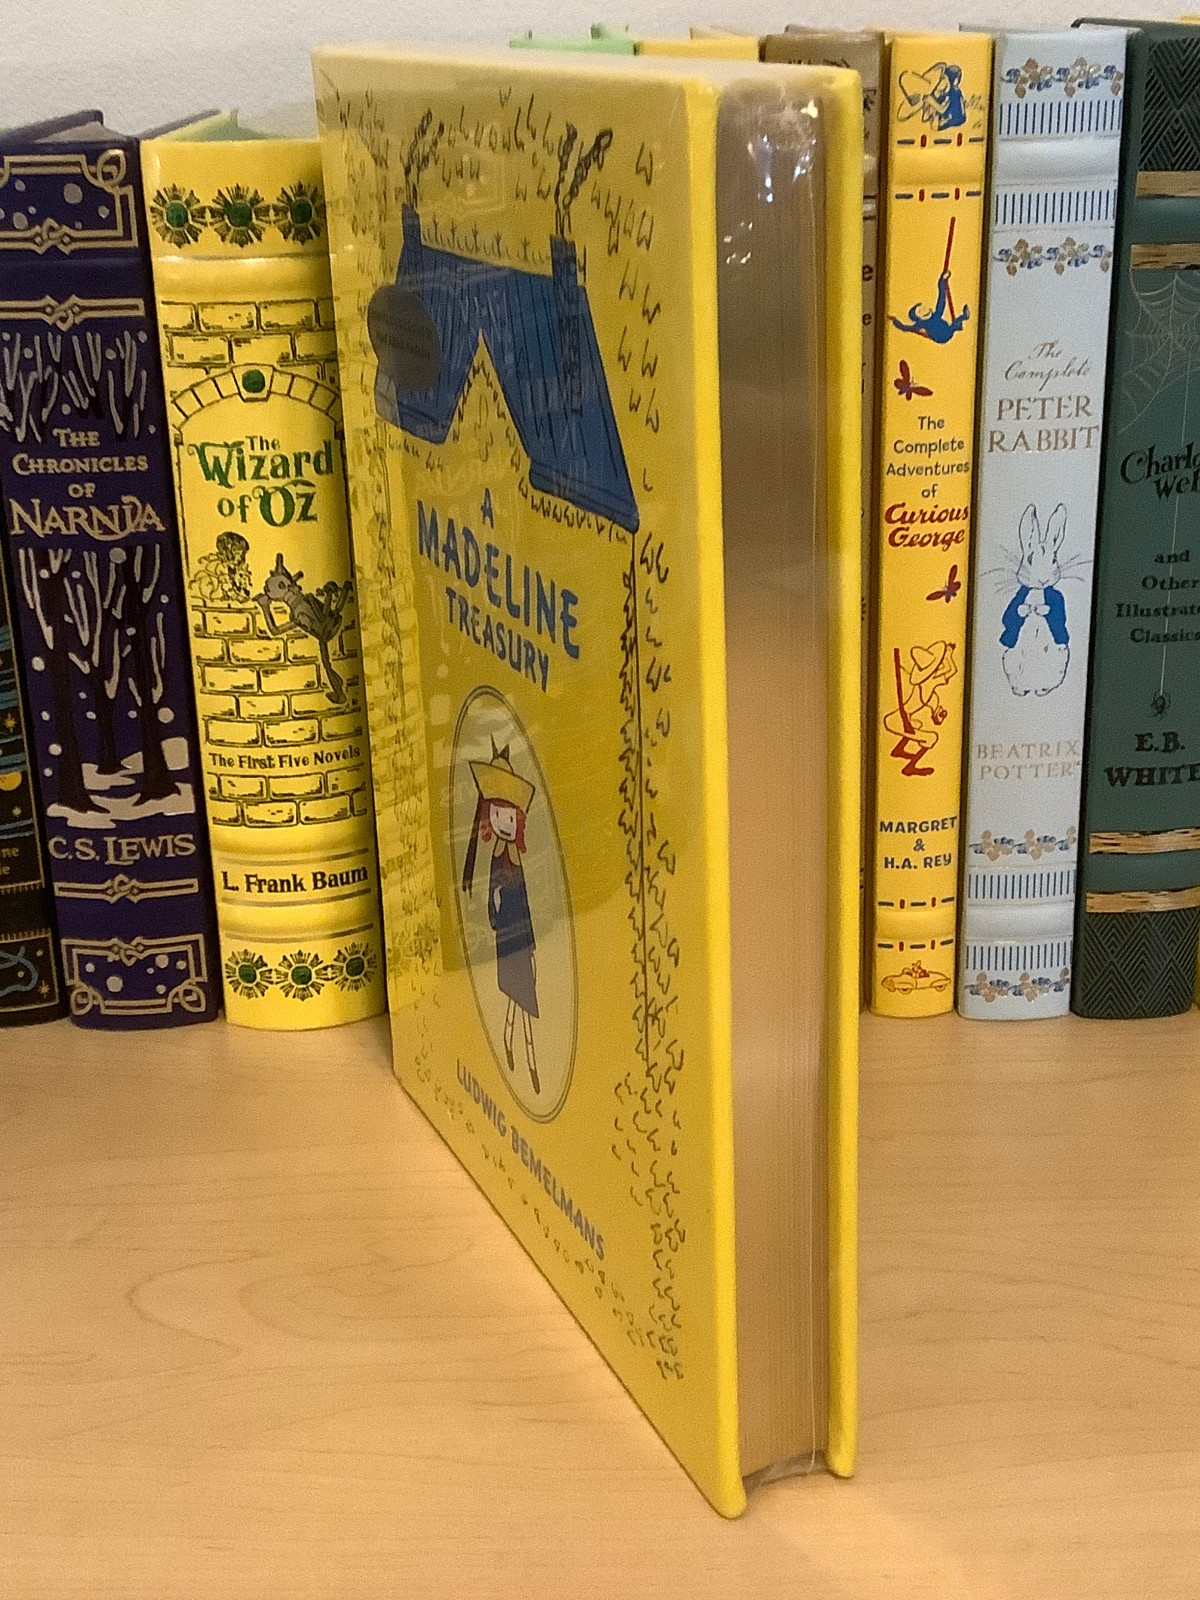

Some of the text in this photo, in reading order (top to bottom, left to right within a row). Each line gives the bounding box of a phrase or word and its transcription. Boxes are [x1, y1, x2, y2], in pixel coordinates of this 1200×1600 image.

[1028, 339, 1063, 359] The
[1004, 356, 1091, 391] Complete
[997, 394, 1092, 420] PETER
[918, 416, 945, 430] The
[245, 435, 281, 451] The
[893, 436, 965, 458] Complete
[988, 425, 1099, 453] RABBIT
[187, 438, 334, 489] Wizard
[886, 461, 970, 477] Adventures
[921, 483, 938, 498] of
[217, 479, 318, 527] of Oz
[480, 487, 494, 528] A
[884, 502, 969, 525] Curious
[9, 495, 166, 541] NARNIA
[888, 526, 965, 552] George
[1154, 550, 1191, 564] and
[417, 500, 580, 660] MADELINE
[1141, 575, 1199, 590] Other
[445, 586, 549, 693] TREASURY
[208, 745, 361, 769] The First Five Novels
[976, 740, 1080, 760] BEATRIX
[980, 761, 1077, 780] POTTER
[1104, 762, 1200, 787] WHITE
[879, 816, 957, 833] MARGRET
[913, 838, 926, 852] &
[884, 853, 952, 869] H.A. REY
[221, 866, 368, 893] L. Frank Baum
[456, 1057, 605, 1261] LUDWIG BEMELMANS
